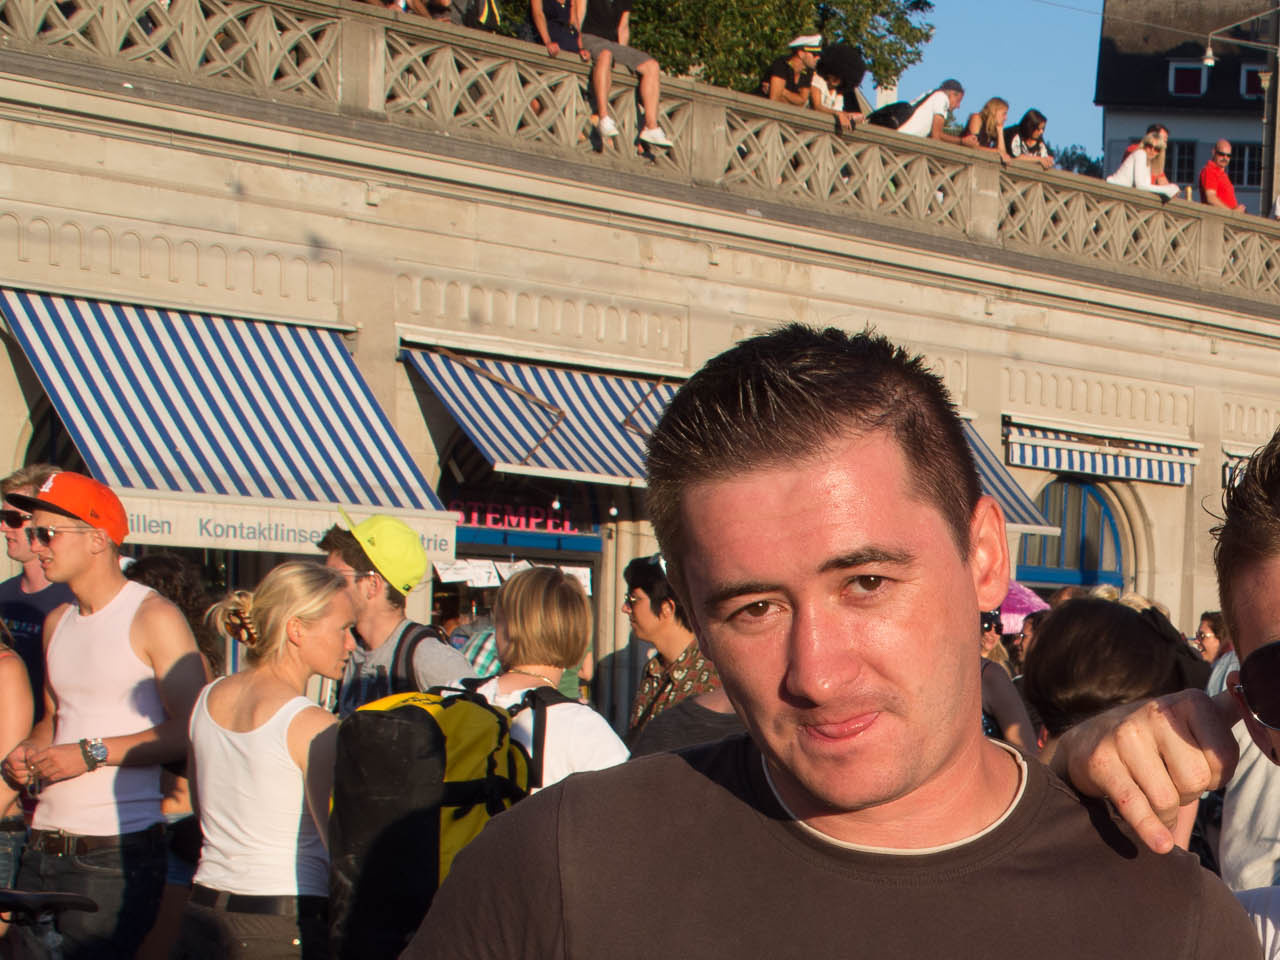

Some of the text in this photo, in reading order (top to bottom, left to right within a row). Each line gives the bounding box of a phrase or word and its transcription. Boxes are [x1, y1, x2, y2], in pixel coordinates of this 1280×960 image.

[129, 514, 332, 545] illen Kontaktlinse
[448, 501, 579, 534] STEMPEL
